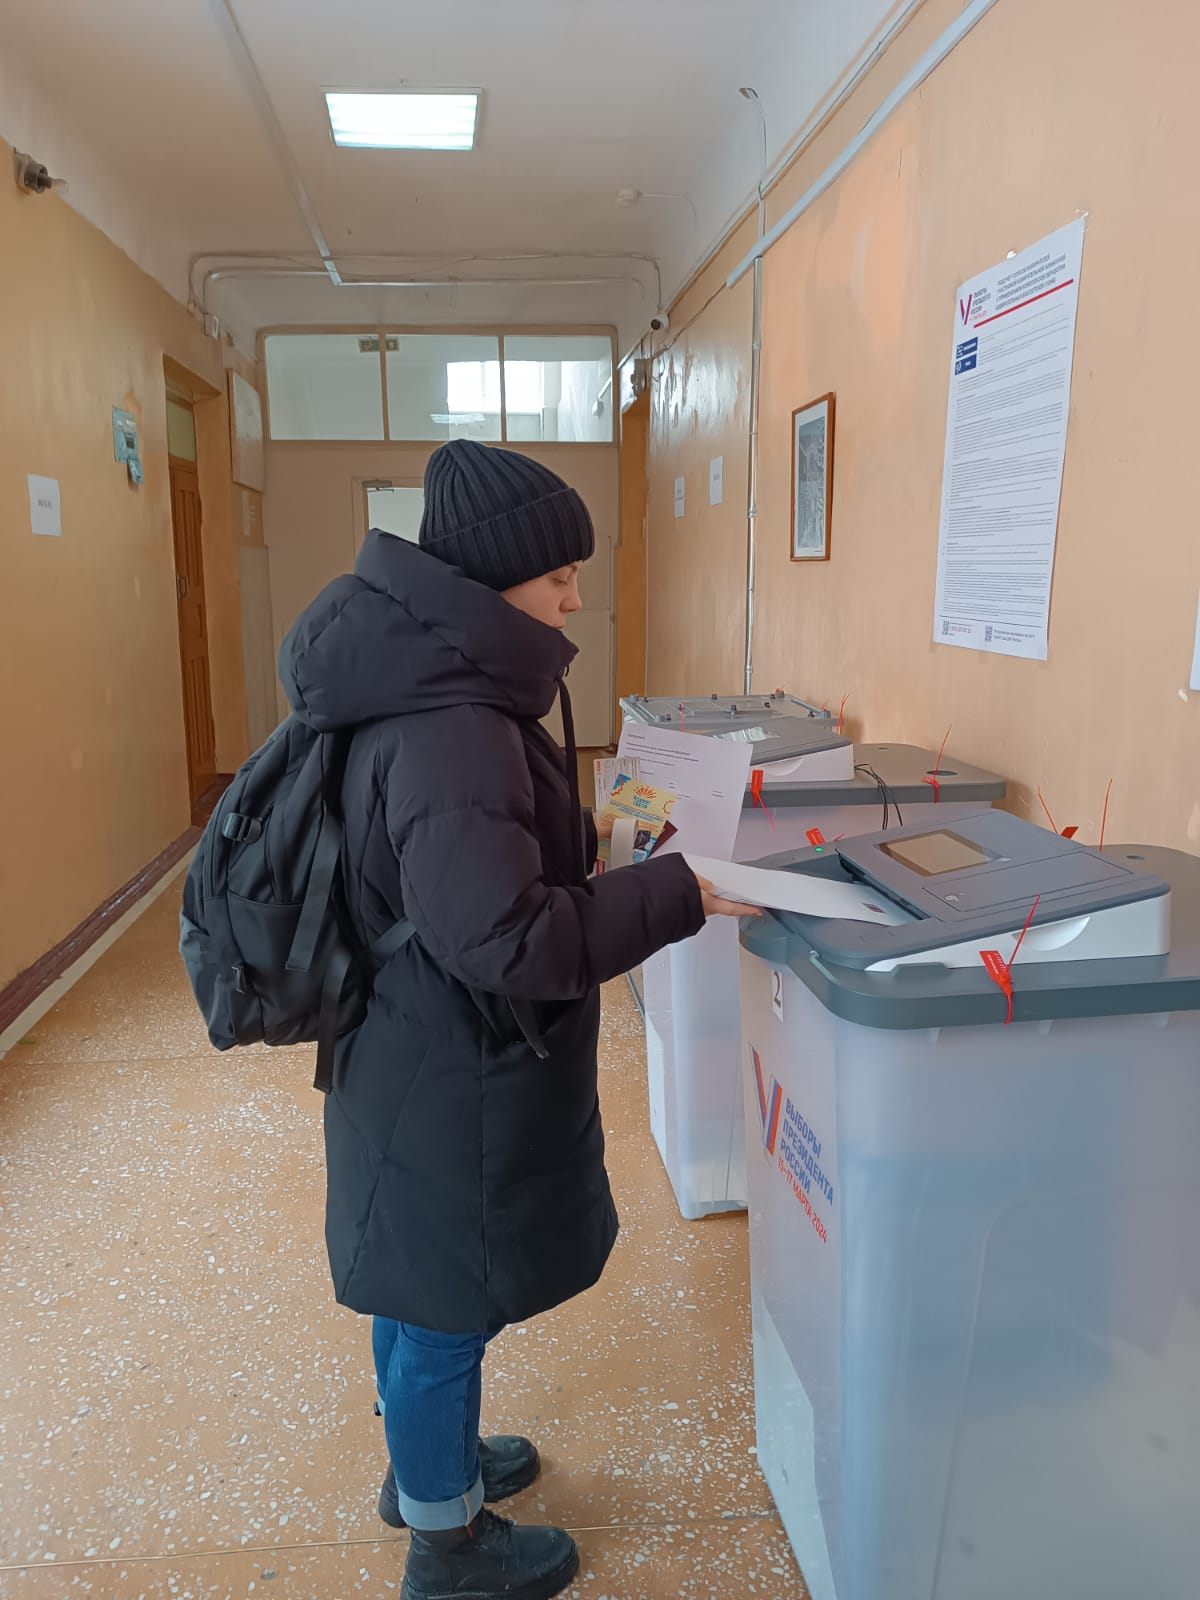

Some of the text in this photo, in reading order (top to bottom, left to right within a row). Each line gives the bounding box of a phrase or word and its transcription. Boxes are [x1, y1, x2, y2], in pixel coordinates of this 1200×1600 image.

[774, 971, 781, 1009] 2
[785, 1098, 822, 1158] ВЫБОРЫ
[780, 1138, 811, 1194] РОССИИ
[782, 1118, 834, 1206] ПРЕЗИДЕНТА
[792, 1181, 812, 1217] МАРТА
[811, 1213, 828, 1245] 2024
